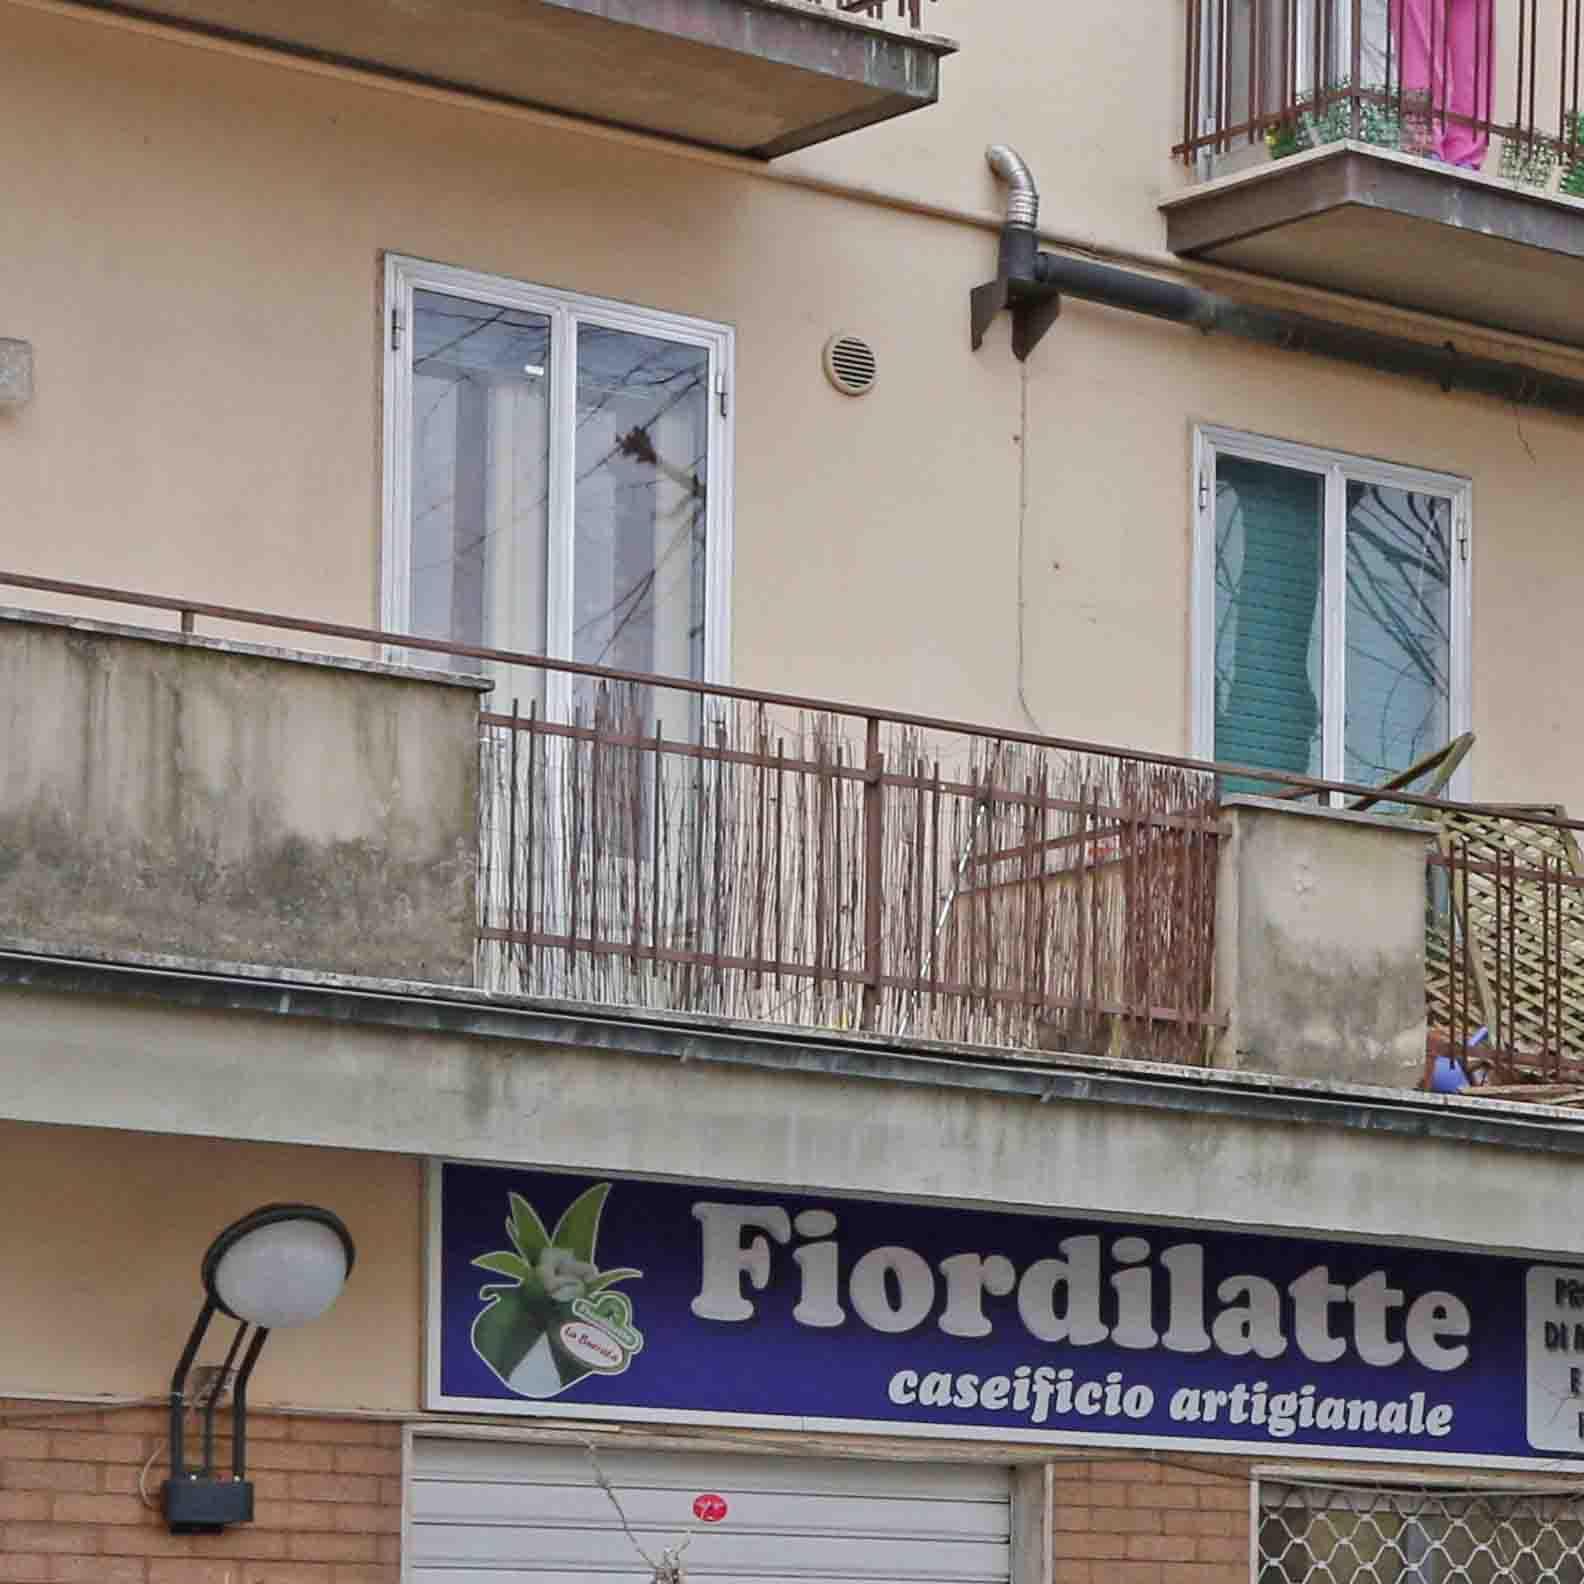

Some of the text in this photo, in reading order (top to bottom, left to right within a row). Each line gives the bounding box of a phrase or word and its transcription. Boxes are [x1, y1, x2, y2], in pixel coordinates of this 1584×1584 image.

[691, 1202, 1470, 1371] Fiordilatte
[1545, 1320, 1569, 1351] DI
[888, 1366, 1453, 1437] caseificio artigianale
[1570, 1367, 1582, 1399] E
